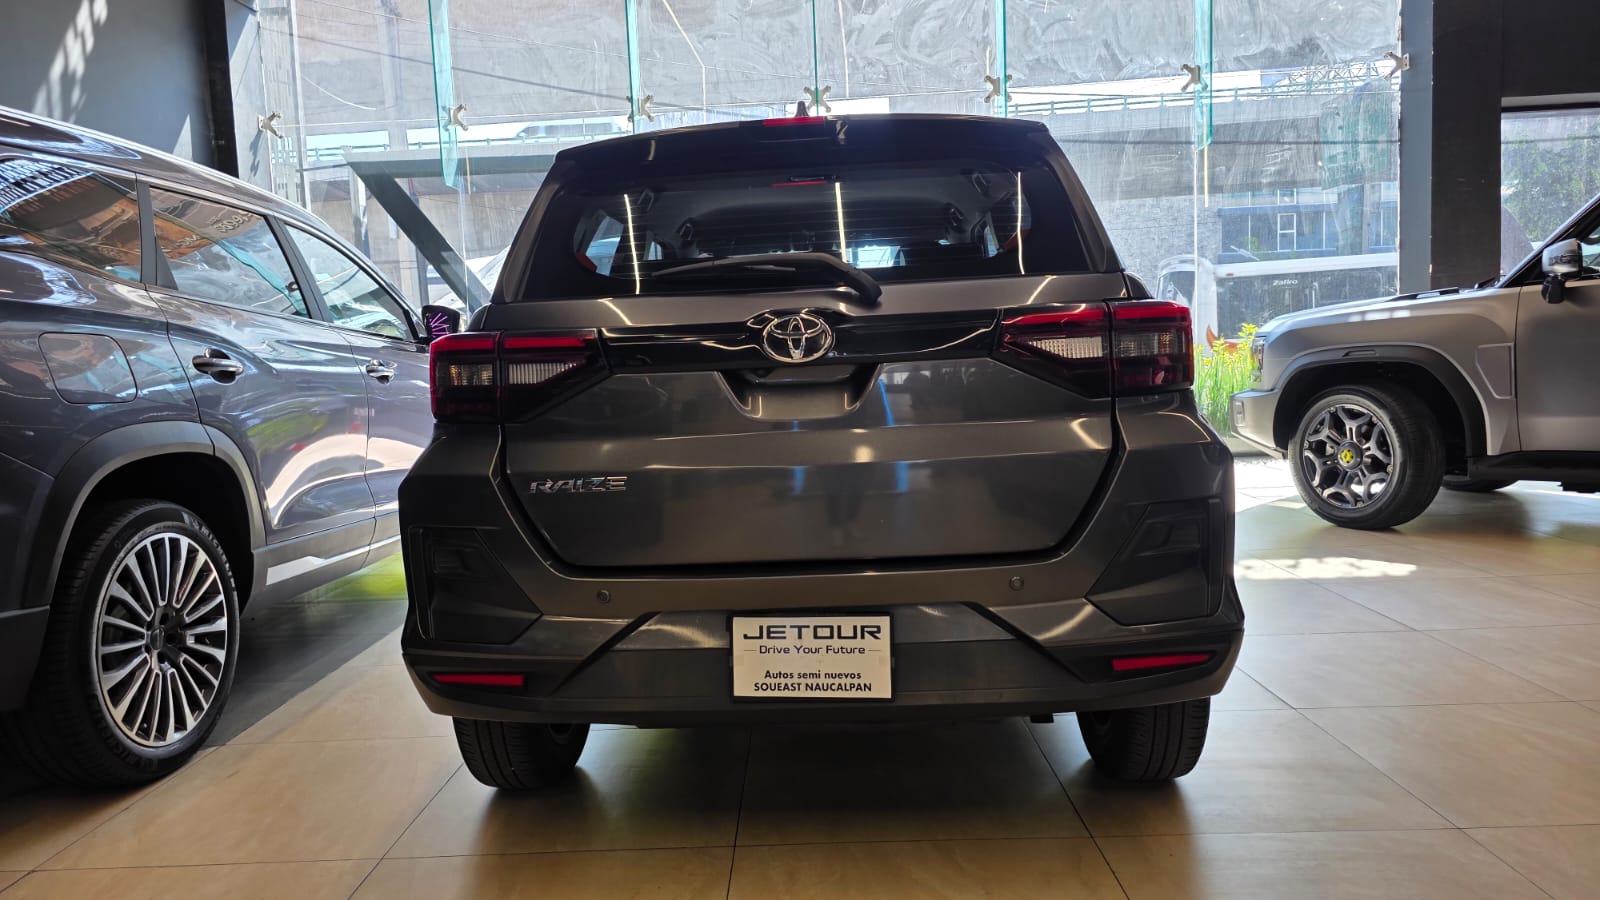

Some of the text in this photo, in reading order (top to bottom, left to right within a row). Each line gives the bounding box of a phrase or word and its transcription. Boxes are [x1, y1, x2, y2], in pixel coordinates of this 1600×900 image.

[529, 475, 628, 493] RAIZE
[743, 624, 881, 640] JETOUR
[759, 645, 866, 654] Drive Your Future
[764, 670, 794, 679] Autos
[797, 670, 821, 679] semi
[754, 682, 872, 691] SOUEAST NAUCALPAN
